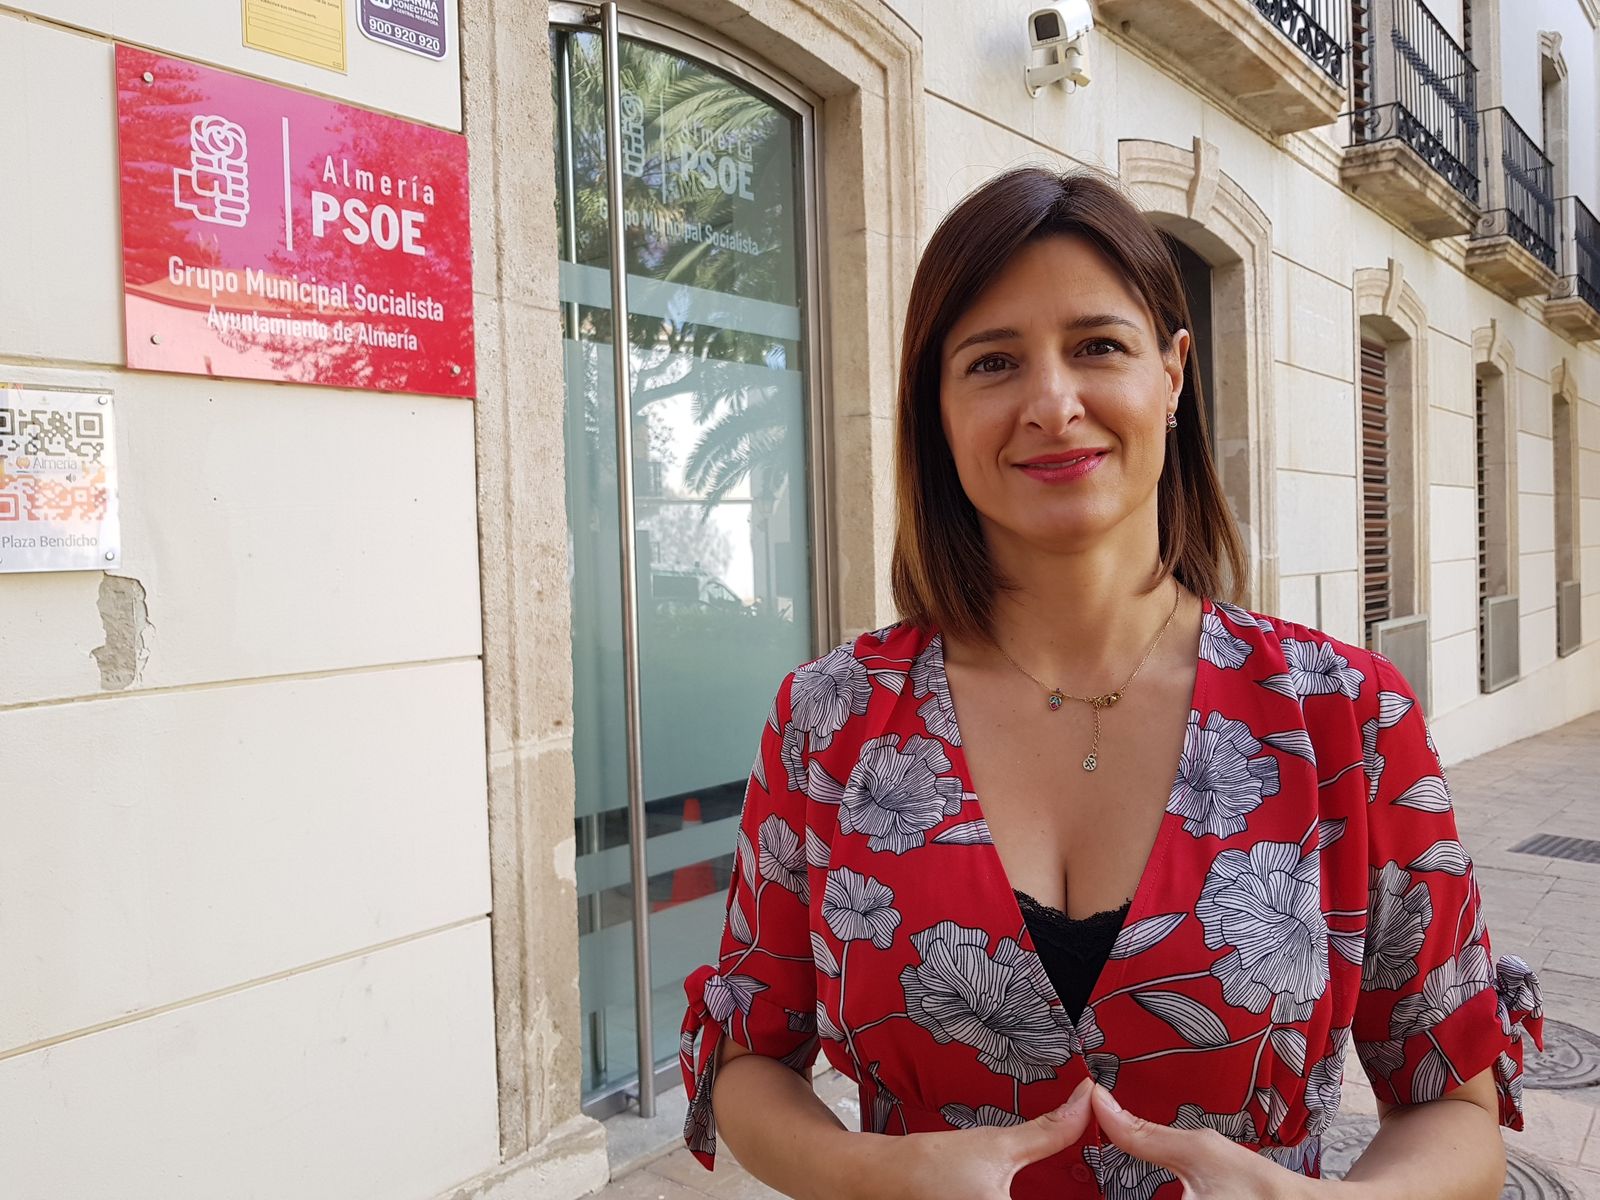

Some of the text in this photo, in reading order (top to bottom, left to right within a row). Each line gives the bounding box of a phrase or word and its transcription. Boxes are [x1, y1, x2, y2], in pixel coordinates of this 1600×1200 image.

[369, 18, 440, 51] 900 920 920
[323, 156, 434, 206] Almería
[681, 143, 755, 201] PSOE
[311, 192, 426, 256] PSOE
[705, 224, 759, 256] Socialista
[168, 255, 444, 322] Grupo Municipal Socialista
[207, 304, 418, 351] Ayuntamiento de Almería
[2, 534, 98, 548] Plaza Bendicho
